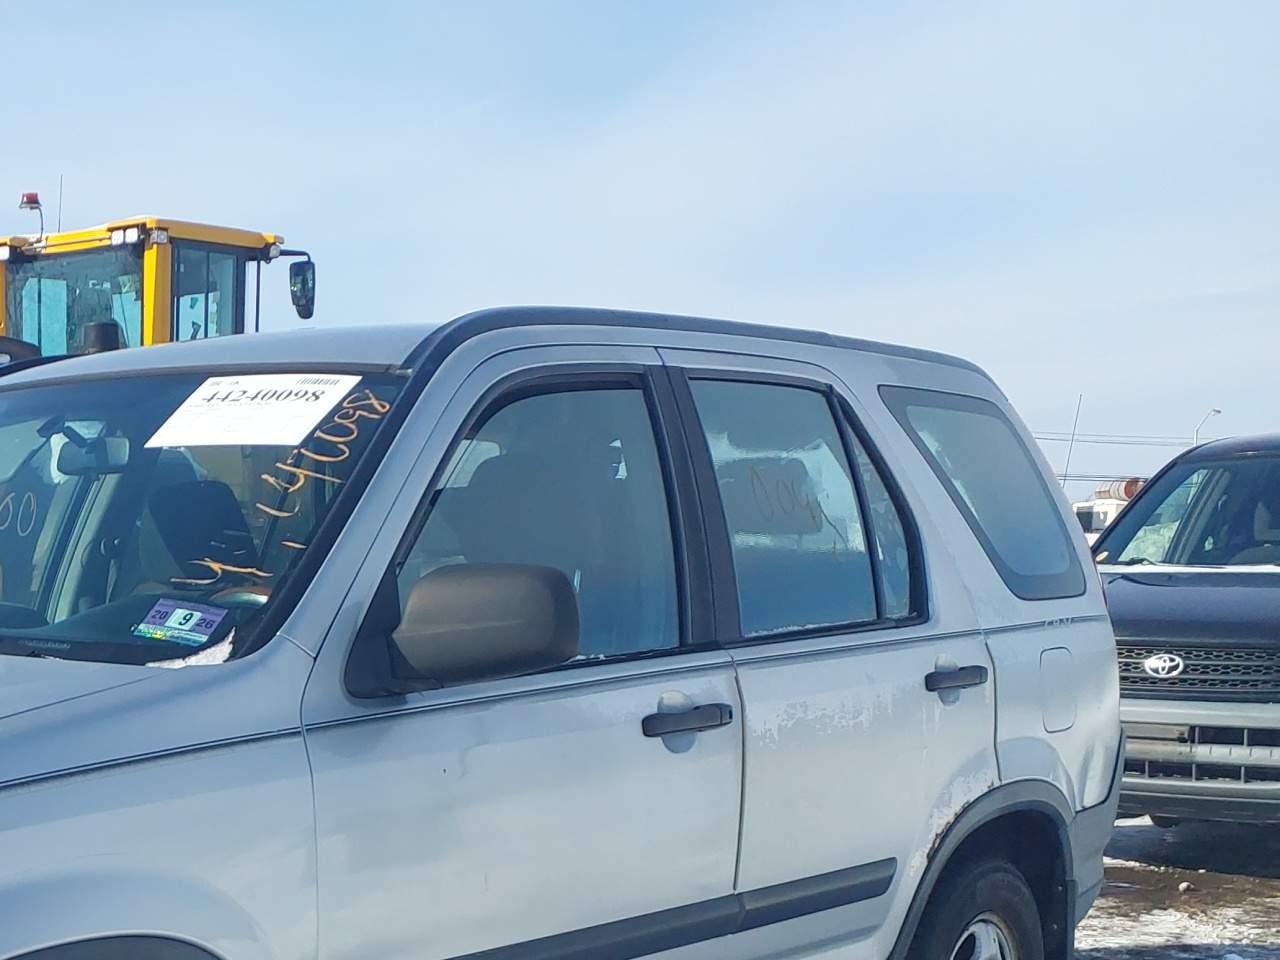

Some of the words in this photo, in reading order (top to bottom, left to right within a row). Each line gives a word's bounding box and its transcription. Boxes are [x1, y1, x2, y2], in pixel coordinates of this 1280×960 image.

[202, 388, 326, 404] 44240098
[151, 609, 169, 620] 20
[178, 612, 194, 626] 9
[197, 618, 213, 629] 26
